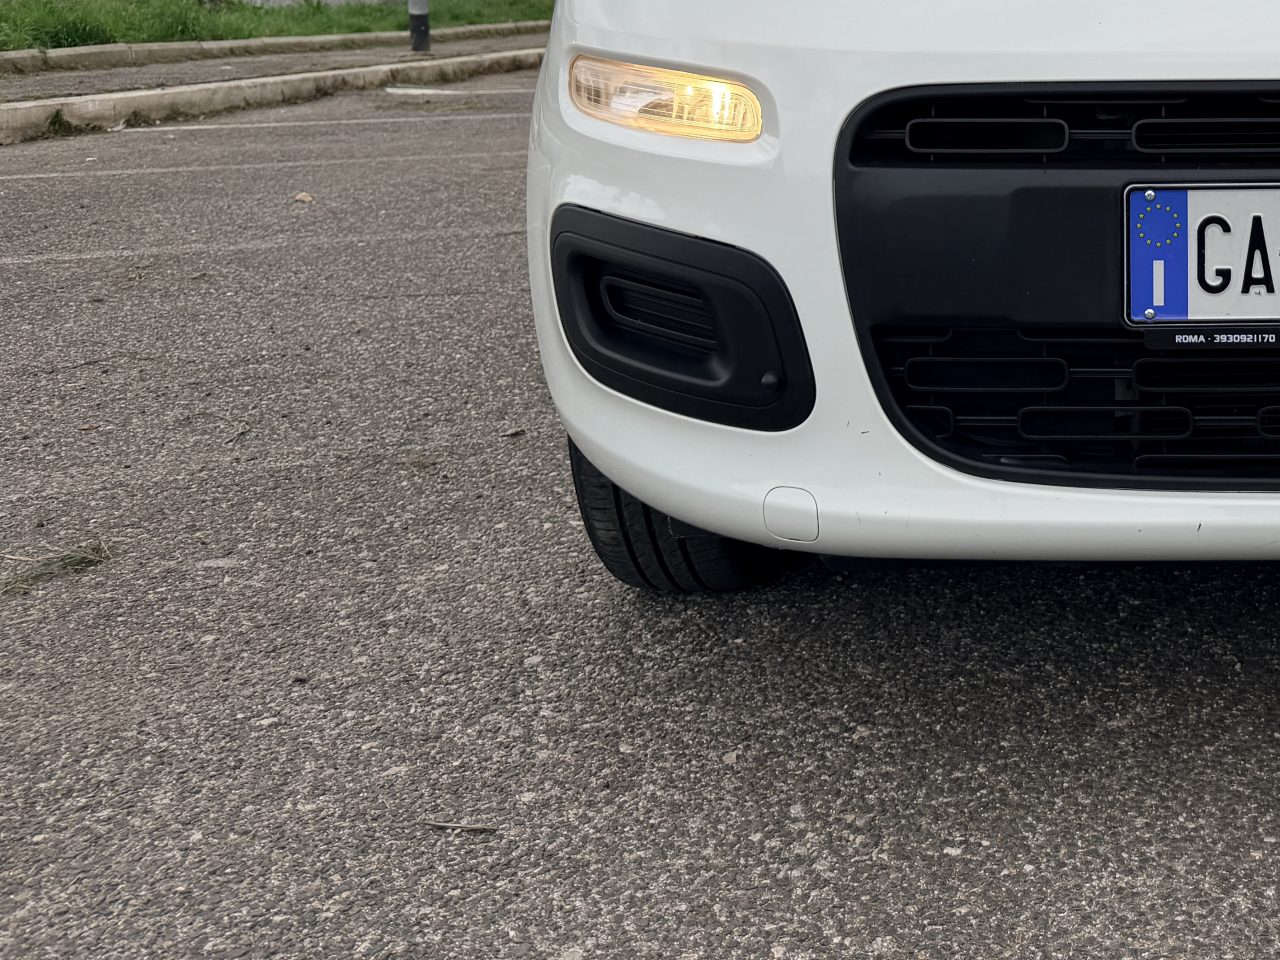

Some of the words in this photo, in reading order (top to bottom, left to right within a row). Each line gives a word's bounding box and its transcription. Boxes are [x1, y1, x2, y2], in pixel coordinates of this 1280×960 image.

[1196, 214, 1276, 295] GA
[1175, 334, 1206, 343] ROMA
[1213, 334, 1276, 343] 3930921170
